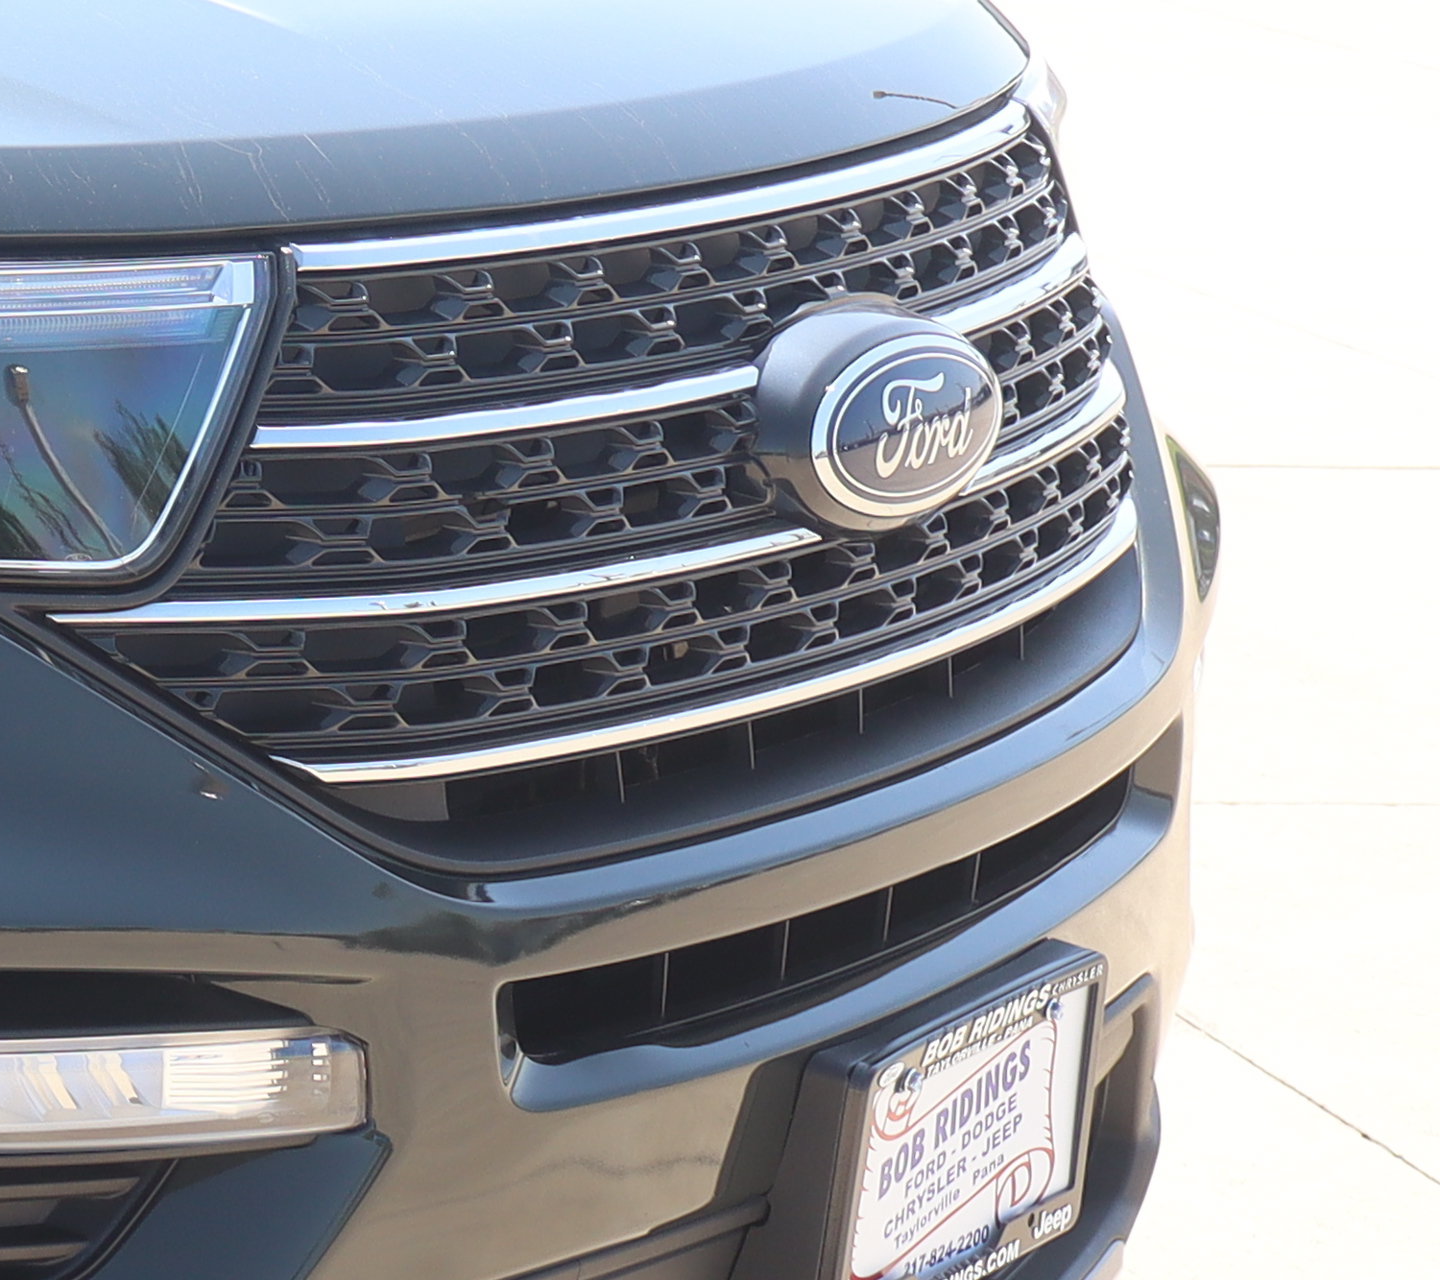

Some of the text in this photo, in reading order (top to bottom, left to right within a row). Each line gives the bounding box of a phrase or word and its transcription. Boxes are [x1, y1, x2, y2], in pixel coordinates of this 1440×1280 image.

[875, 372, 974, 478] Ford
[922, 982, 1053, 1068] BOB RIDINGS
[1051, 963, 1104, 996] CHRYSLER
[878, 1039, 1031, 1201] BOB RIDINGS
[904, 1150, 947, 1200] FORD
[961, 1092, 1018, 1151] DODGE
[884, 1160, 968, 1239] CHRYSLER
[981, 1112, 1023, 1158] JEEP
[894, 1153, 1005, 1251] Taylorville Pana
[1033, 1204, 1072, 1239] Jeep
[903, 1224, 990, 1276] 217-824-2200
